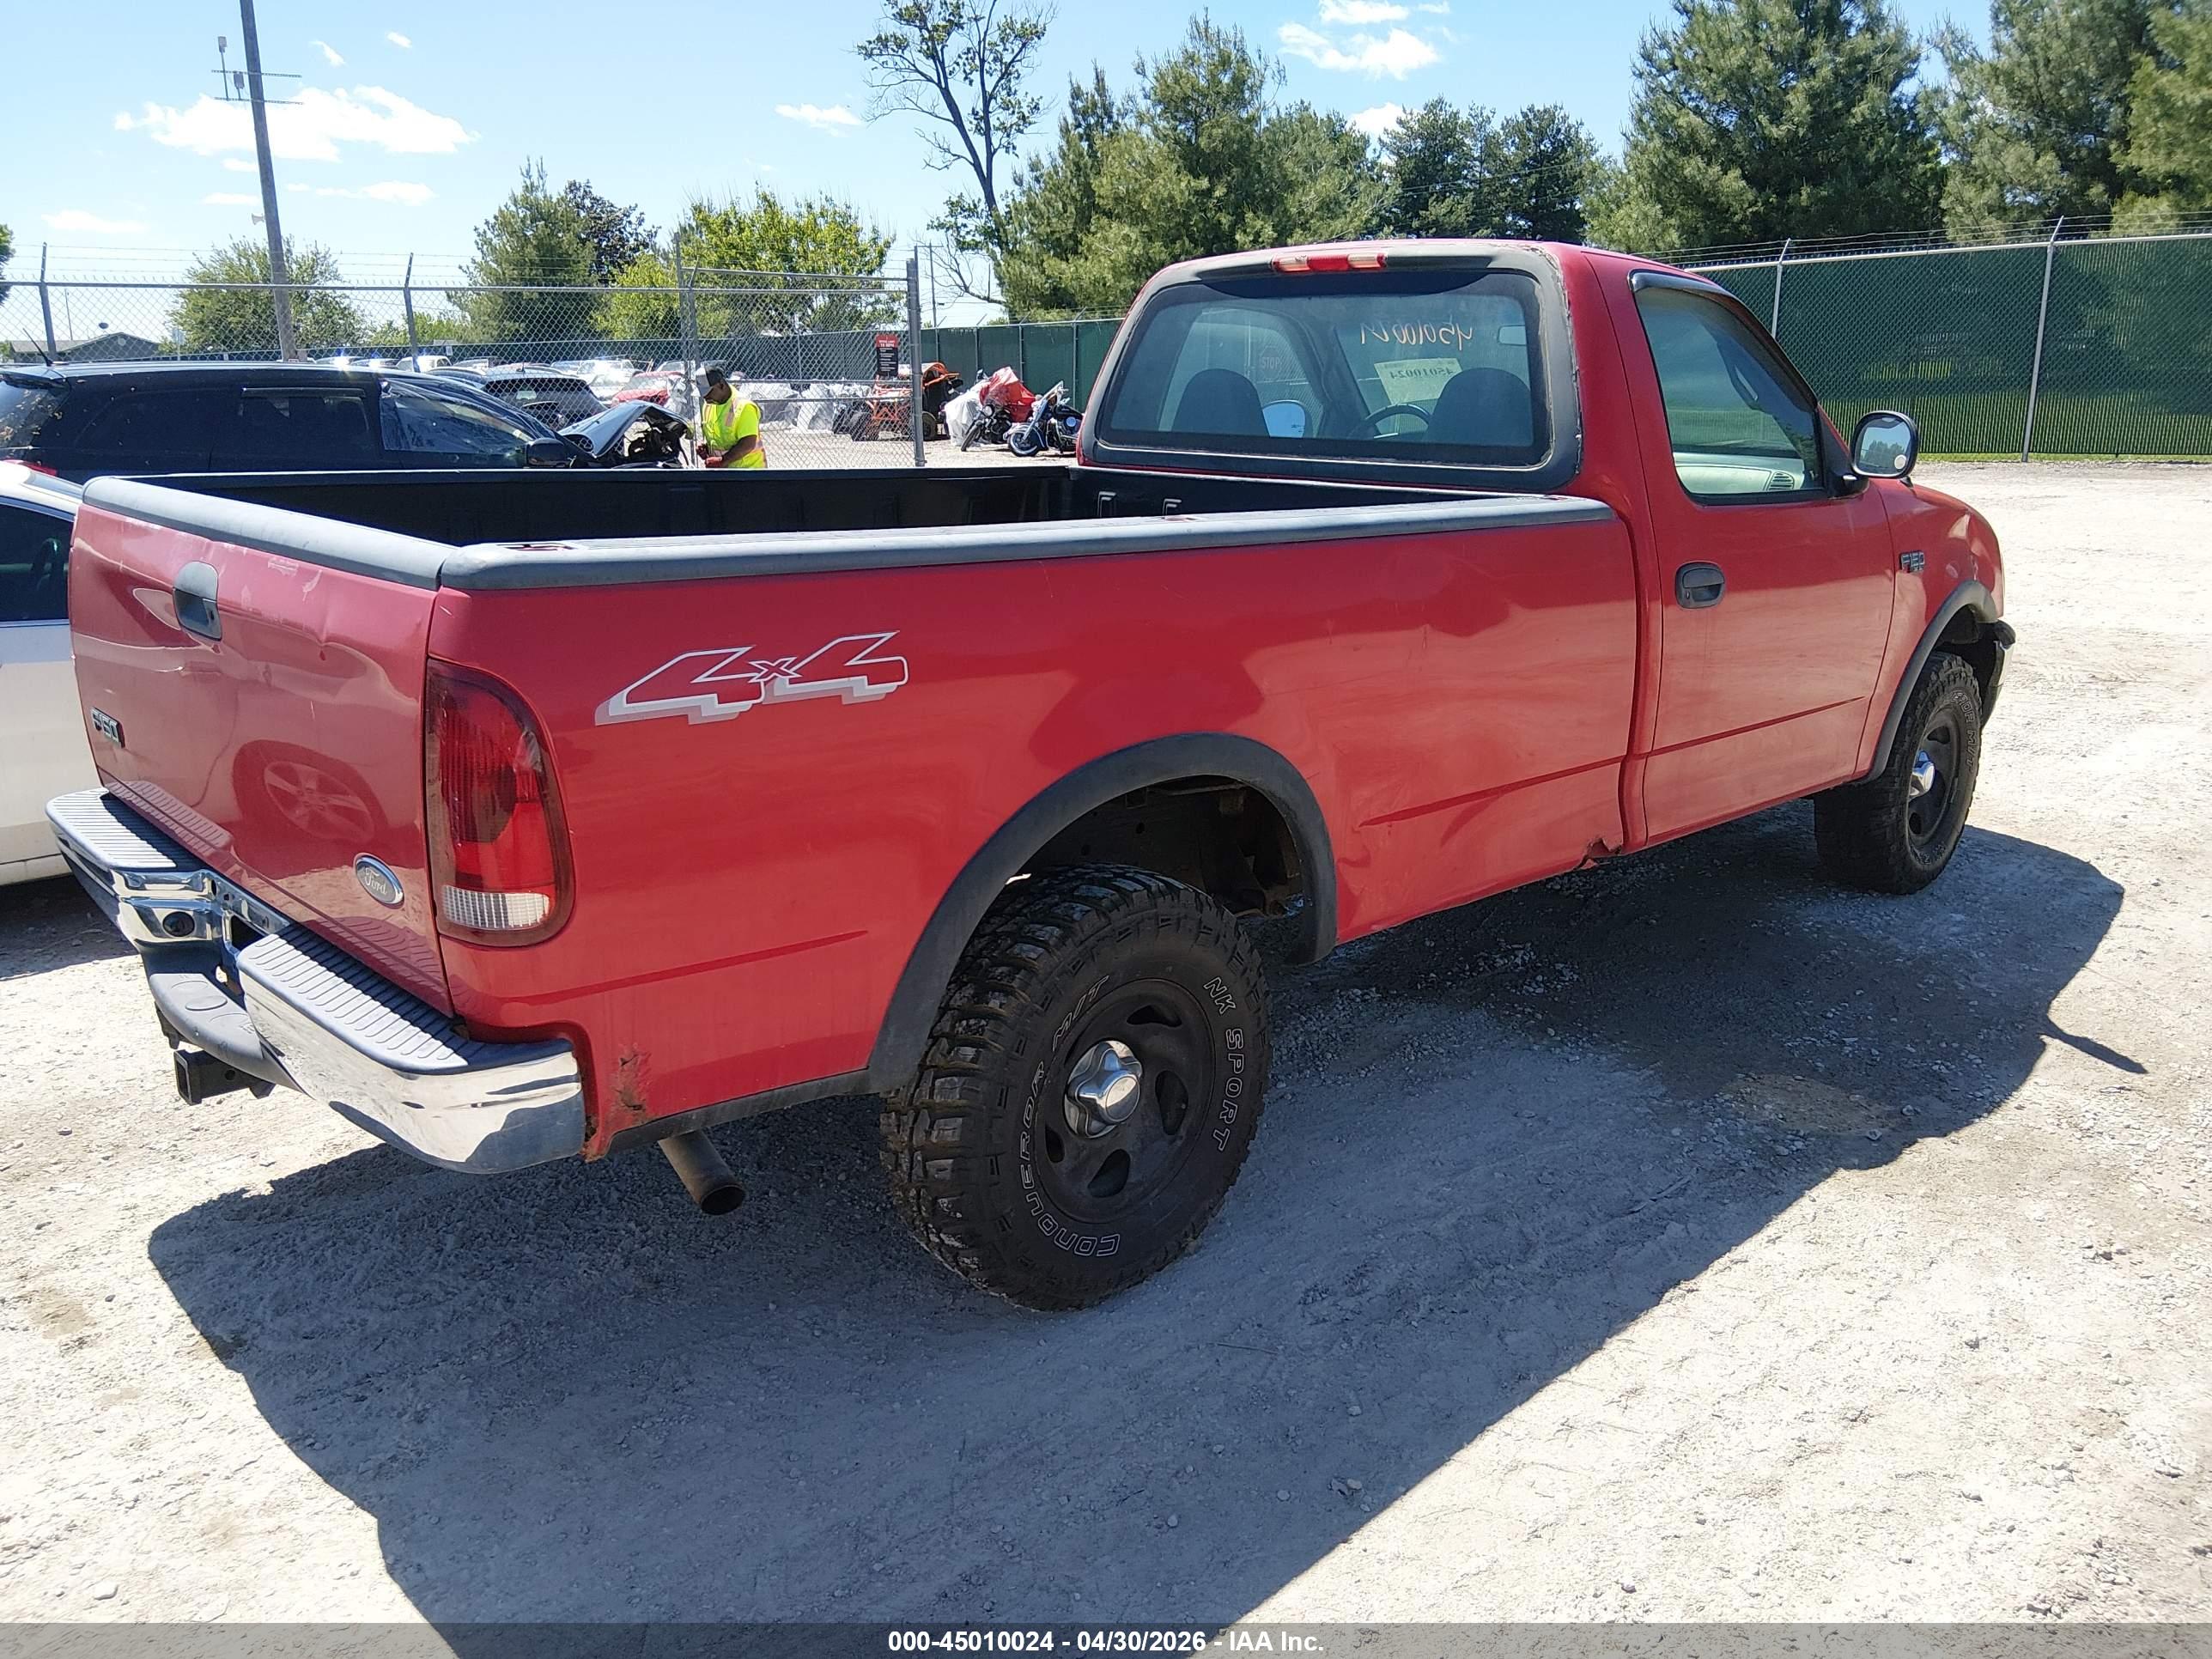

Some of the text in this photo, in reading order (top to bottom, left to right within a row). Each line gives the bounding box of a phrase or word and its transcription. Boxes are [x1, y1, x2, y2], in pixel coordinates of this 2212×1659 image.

[1260, 356, 1281, 369] STOP
[364, 866, 388, 896] Ford
[1203, 976, 1245, 1152] NK SPORT
[1018, 1060, 1121, 1257] CONQUEROR
